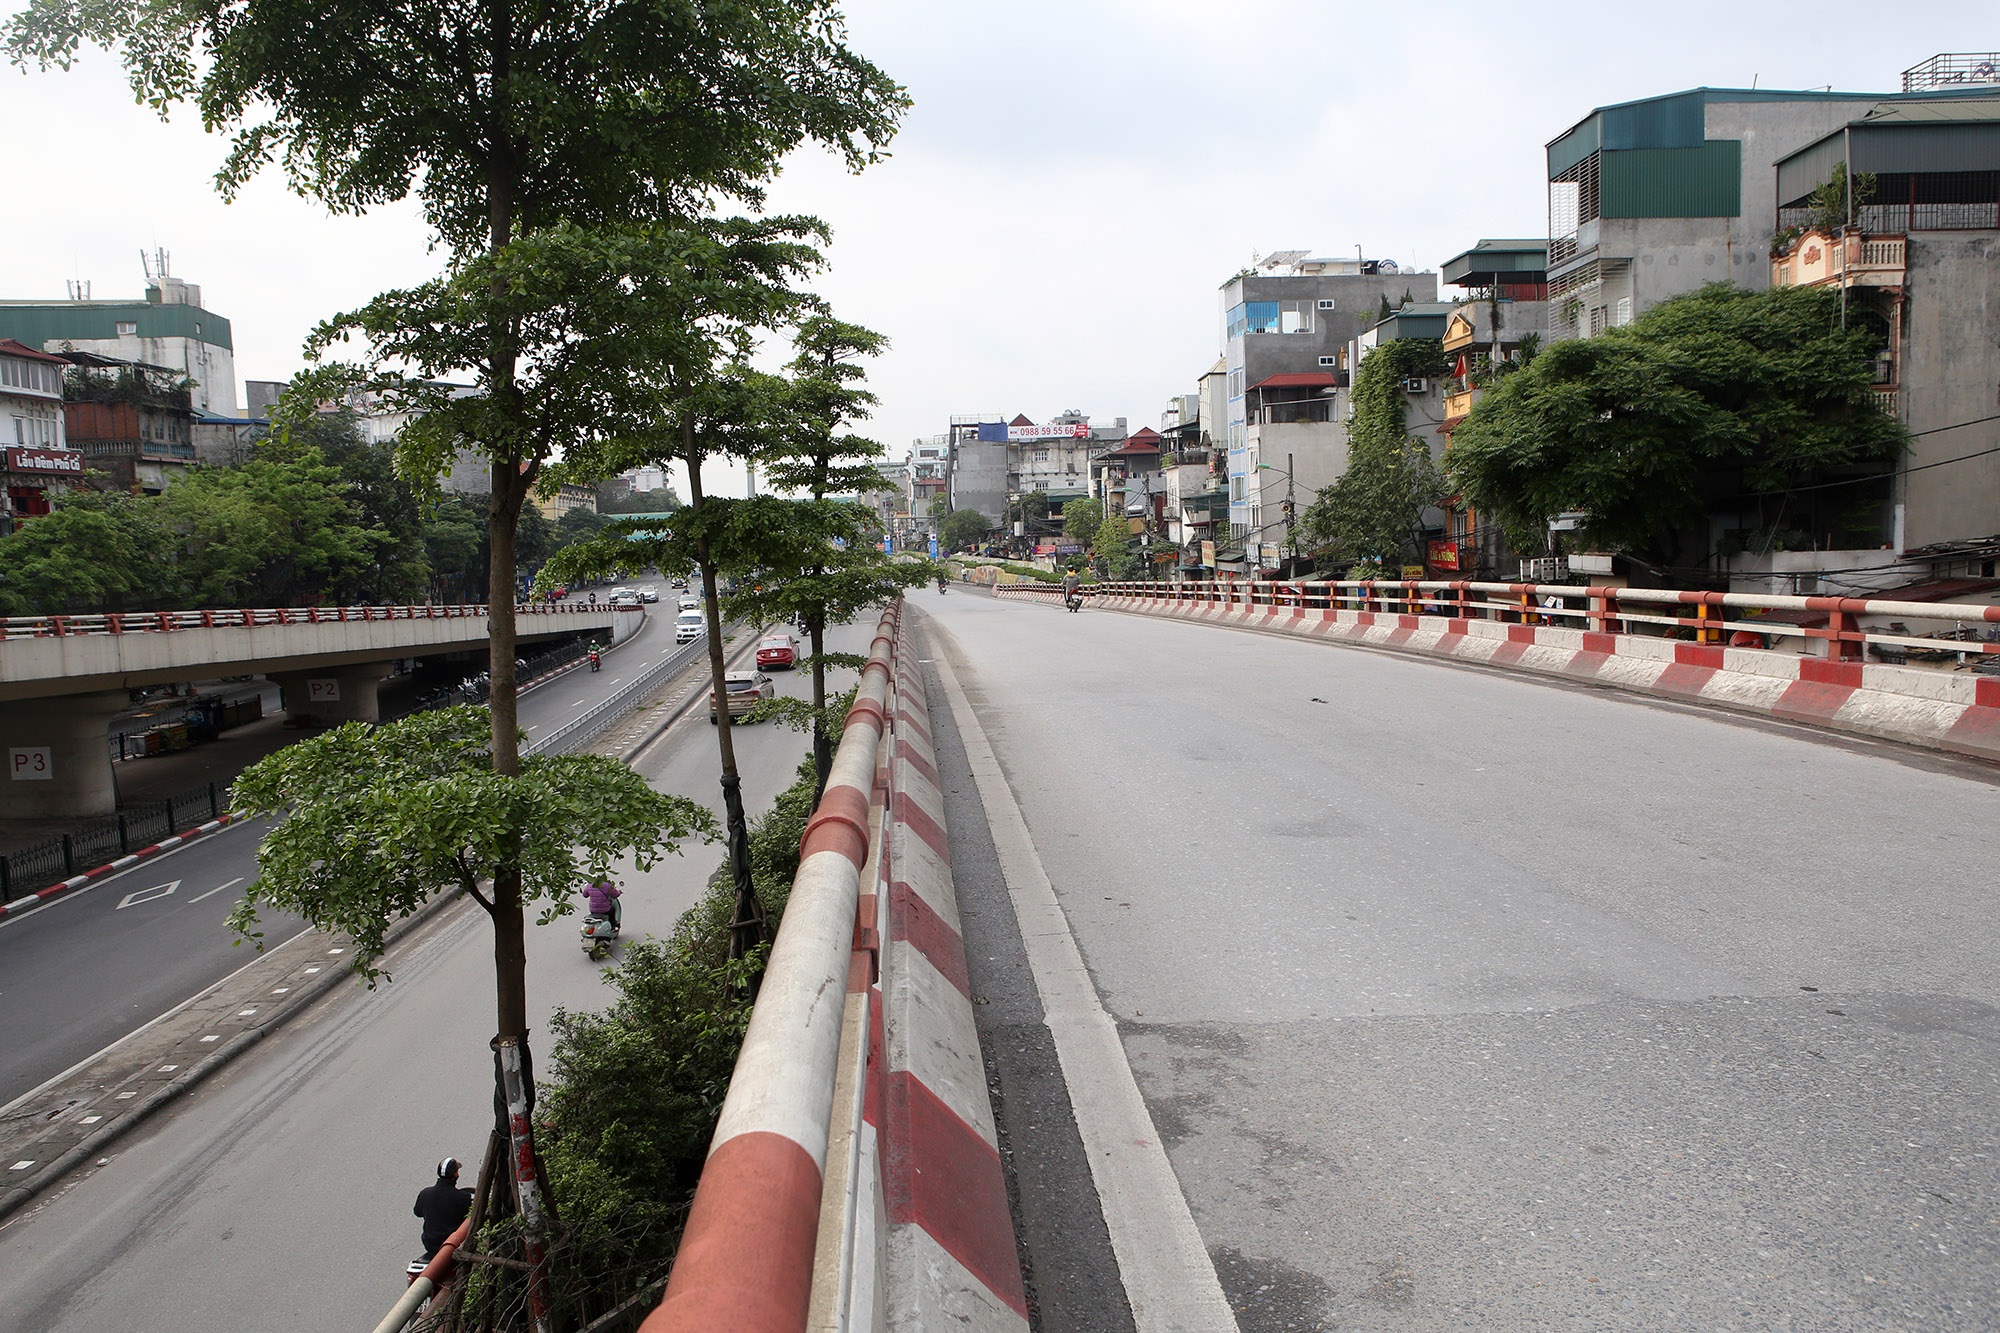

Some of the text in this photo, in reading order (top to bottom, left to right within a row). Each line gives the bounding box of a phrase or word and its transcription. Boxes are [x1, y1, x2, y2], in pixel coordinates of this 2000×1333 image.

[1020, 427, 1039, 436] 0988
[1041, 427, 1051, 435] 59
[1053, 426, 1063, 435] 55
[1064, 426, 1075, 435] 66
[16, 450, 34, 468] Lẩu
[34, 454, 54, 469] Đêm
[53, 454, 70, 470] Phố
